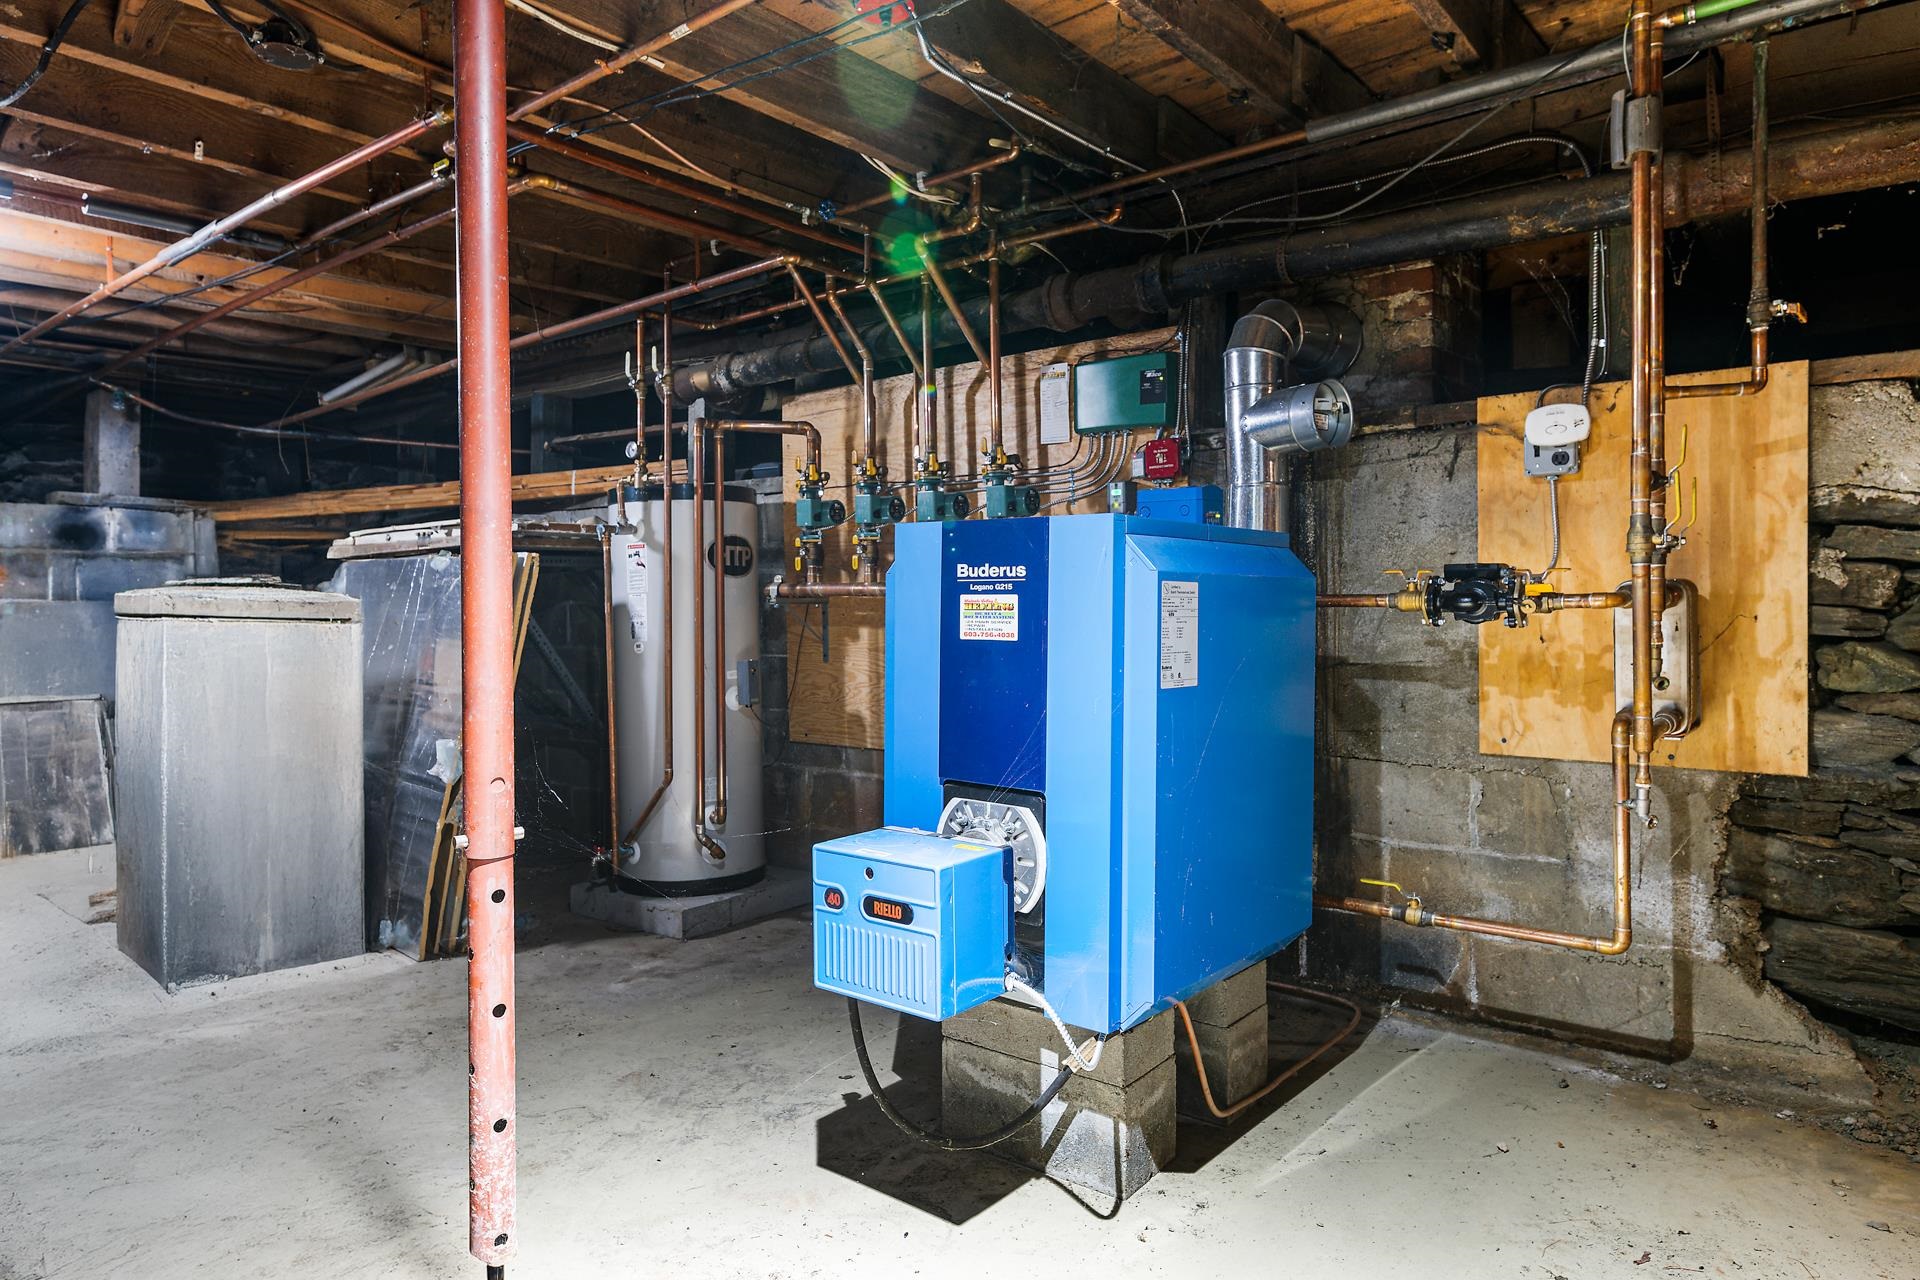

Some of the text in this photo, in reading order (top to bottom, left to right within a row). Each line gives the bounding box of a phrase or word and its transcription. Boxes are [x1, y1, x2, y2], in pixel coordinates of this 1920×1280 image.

[957, 563, 1026, 577] Buderus
[970, 583, 994, 591] Logano
[963, 602, 1015, 611] HEATING
[827, 892, 841, 906] 40
[874, 901, 902, 919] RIELLO
